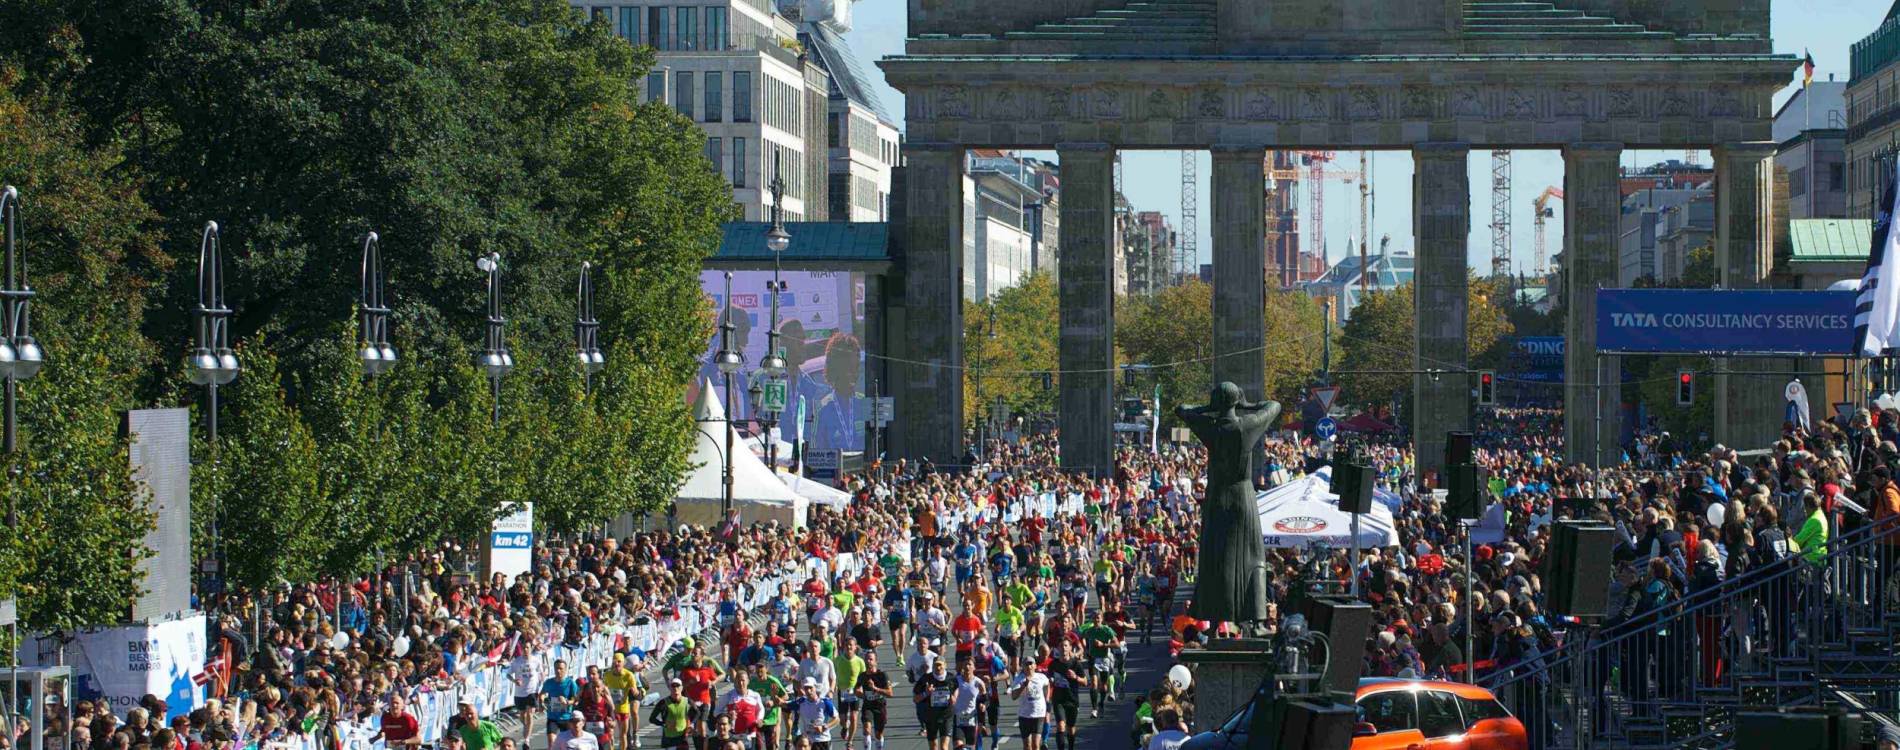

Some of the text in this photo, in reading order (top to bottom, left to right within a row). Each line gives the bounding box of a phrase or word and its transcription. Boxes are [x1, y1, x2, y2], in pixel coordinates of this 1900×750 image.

[1610, 312, 1848, 329] TATA CONSULTANCY SERVICES
[494, 534, 529, 546] km 42
